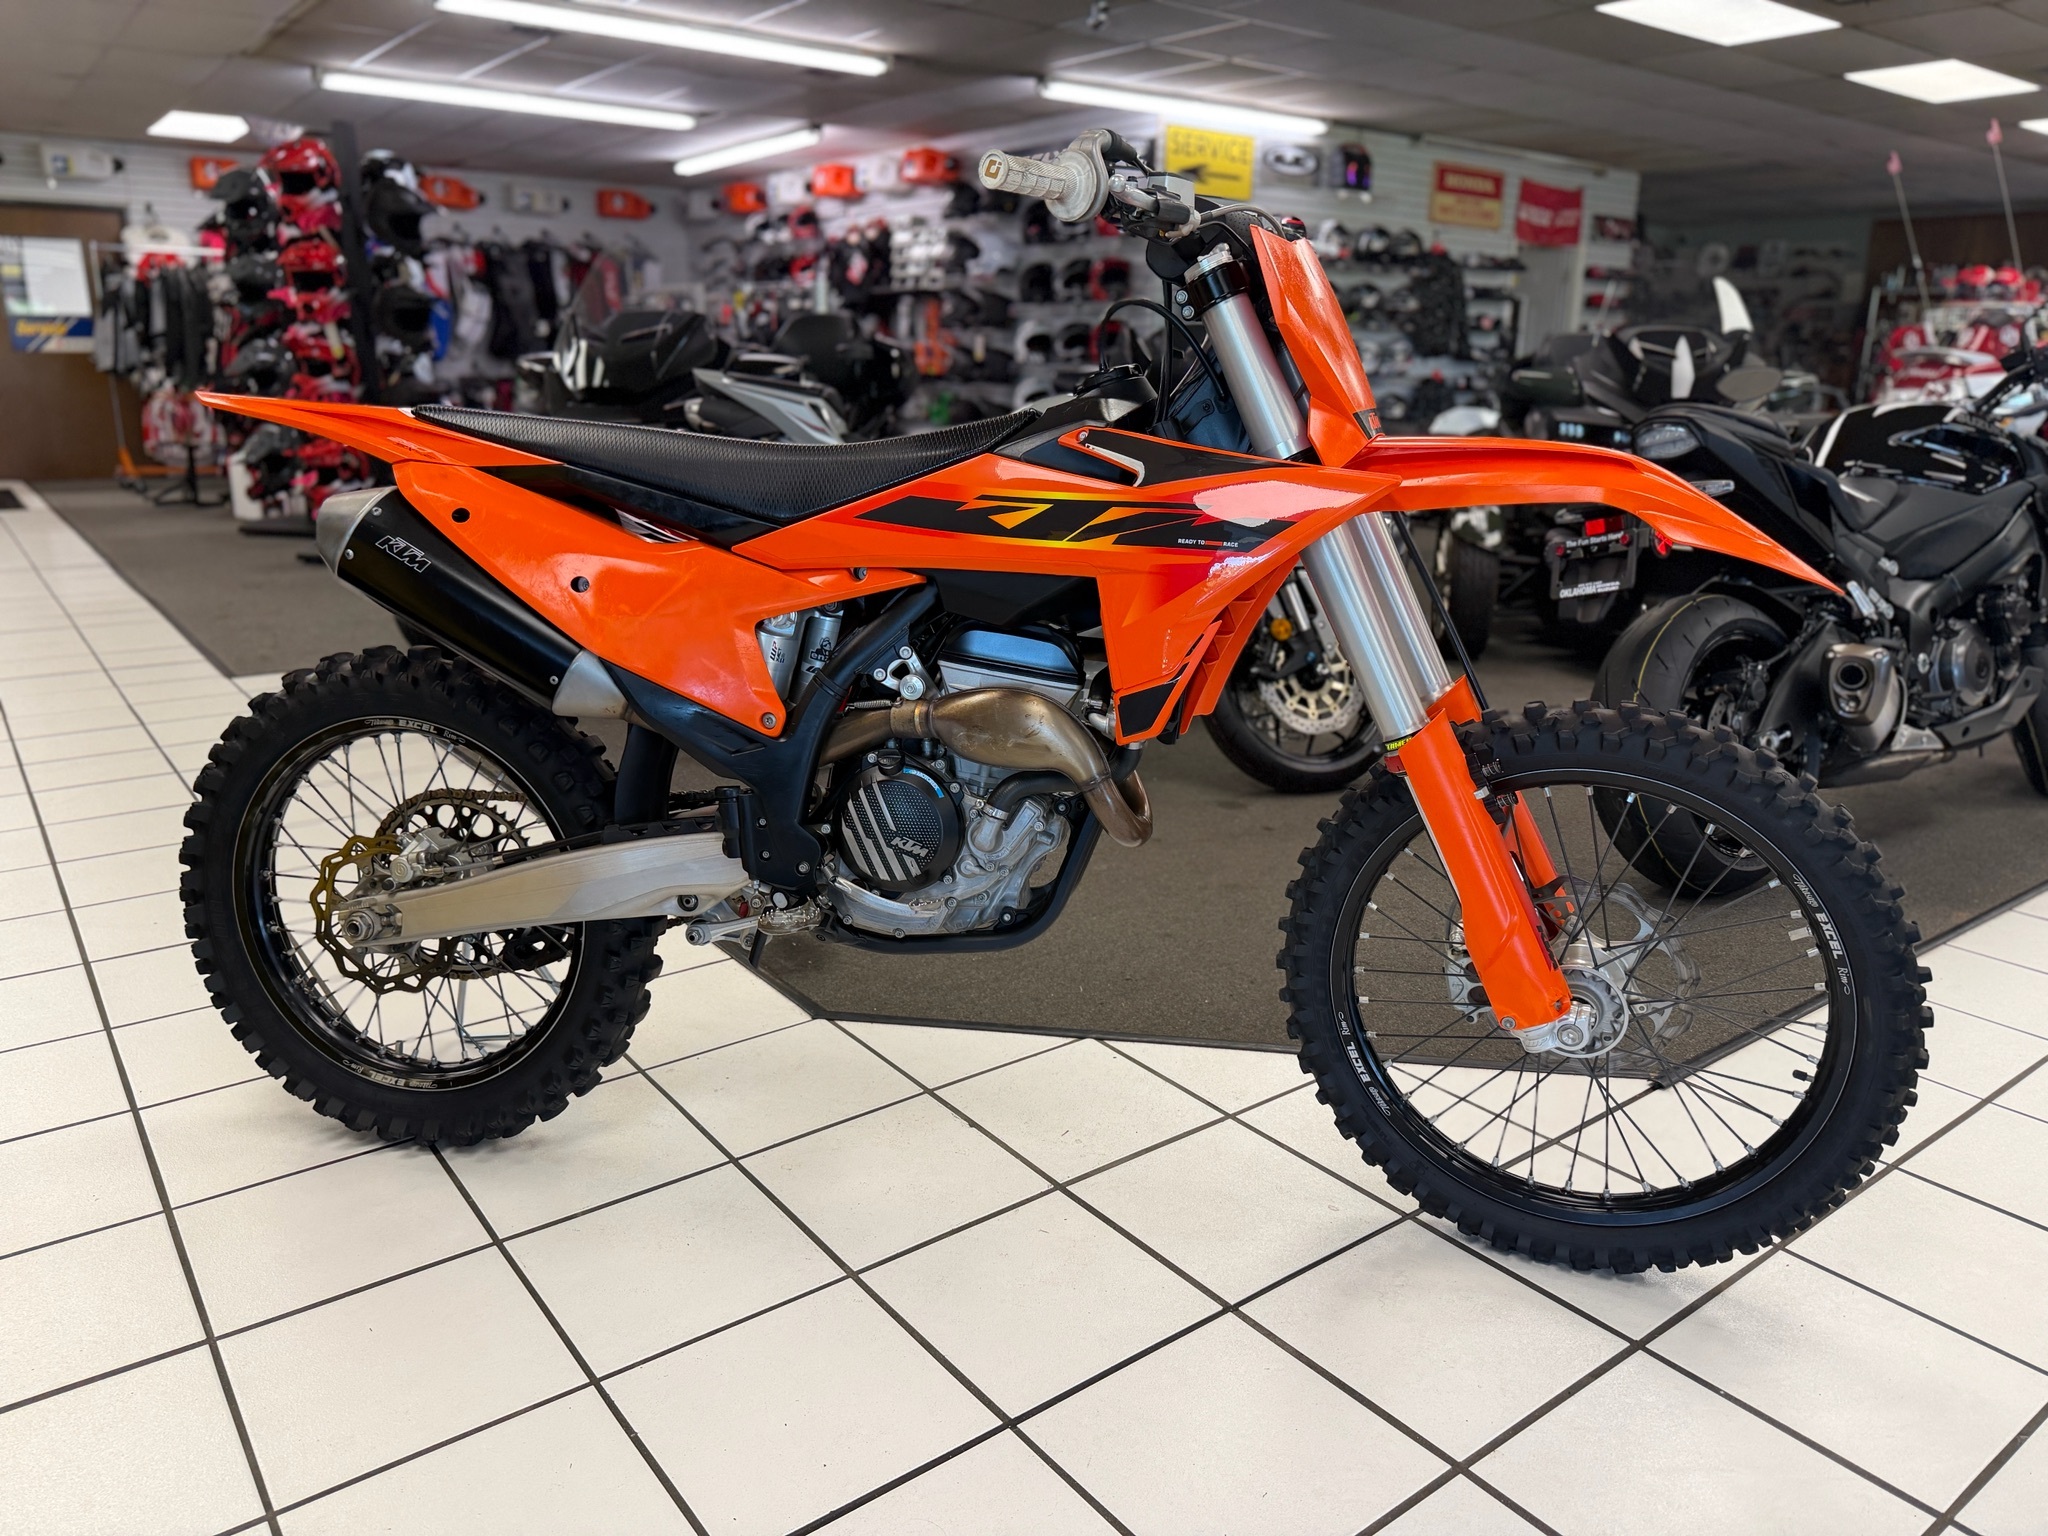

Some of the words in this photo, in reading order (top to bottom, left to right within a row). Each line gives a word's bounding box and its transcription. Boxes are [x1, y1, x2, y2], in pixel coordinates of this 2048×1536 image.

[1171, 131, 1249, 166] SERVICE
[1590, 535, 1607, 544] Starts
[375, 535, 432, 573] KTM
[1559, 583, 1597, 598] OKLAHOMA
[398, 719, 438, 733] EXCEL
[891, 836, 930, 858] KTM
[1815, 912, 1844, 960] EXCEL
[1837, 966, 1850, 996] Rim
[1346, 1041, 1371, 1083] EXCEL
[369, 1070, 406, 1086] EXCEL
